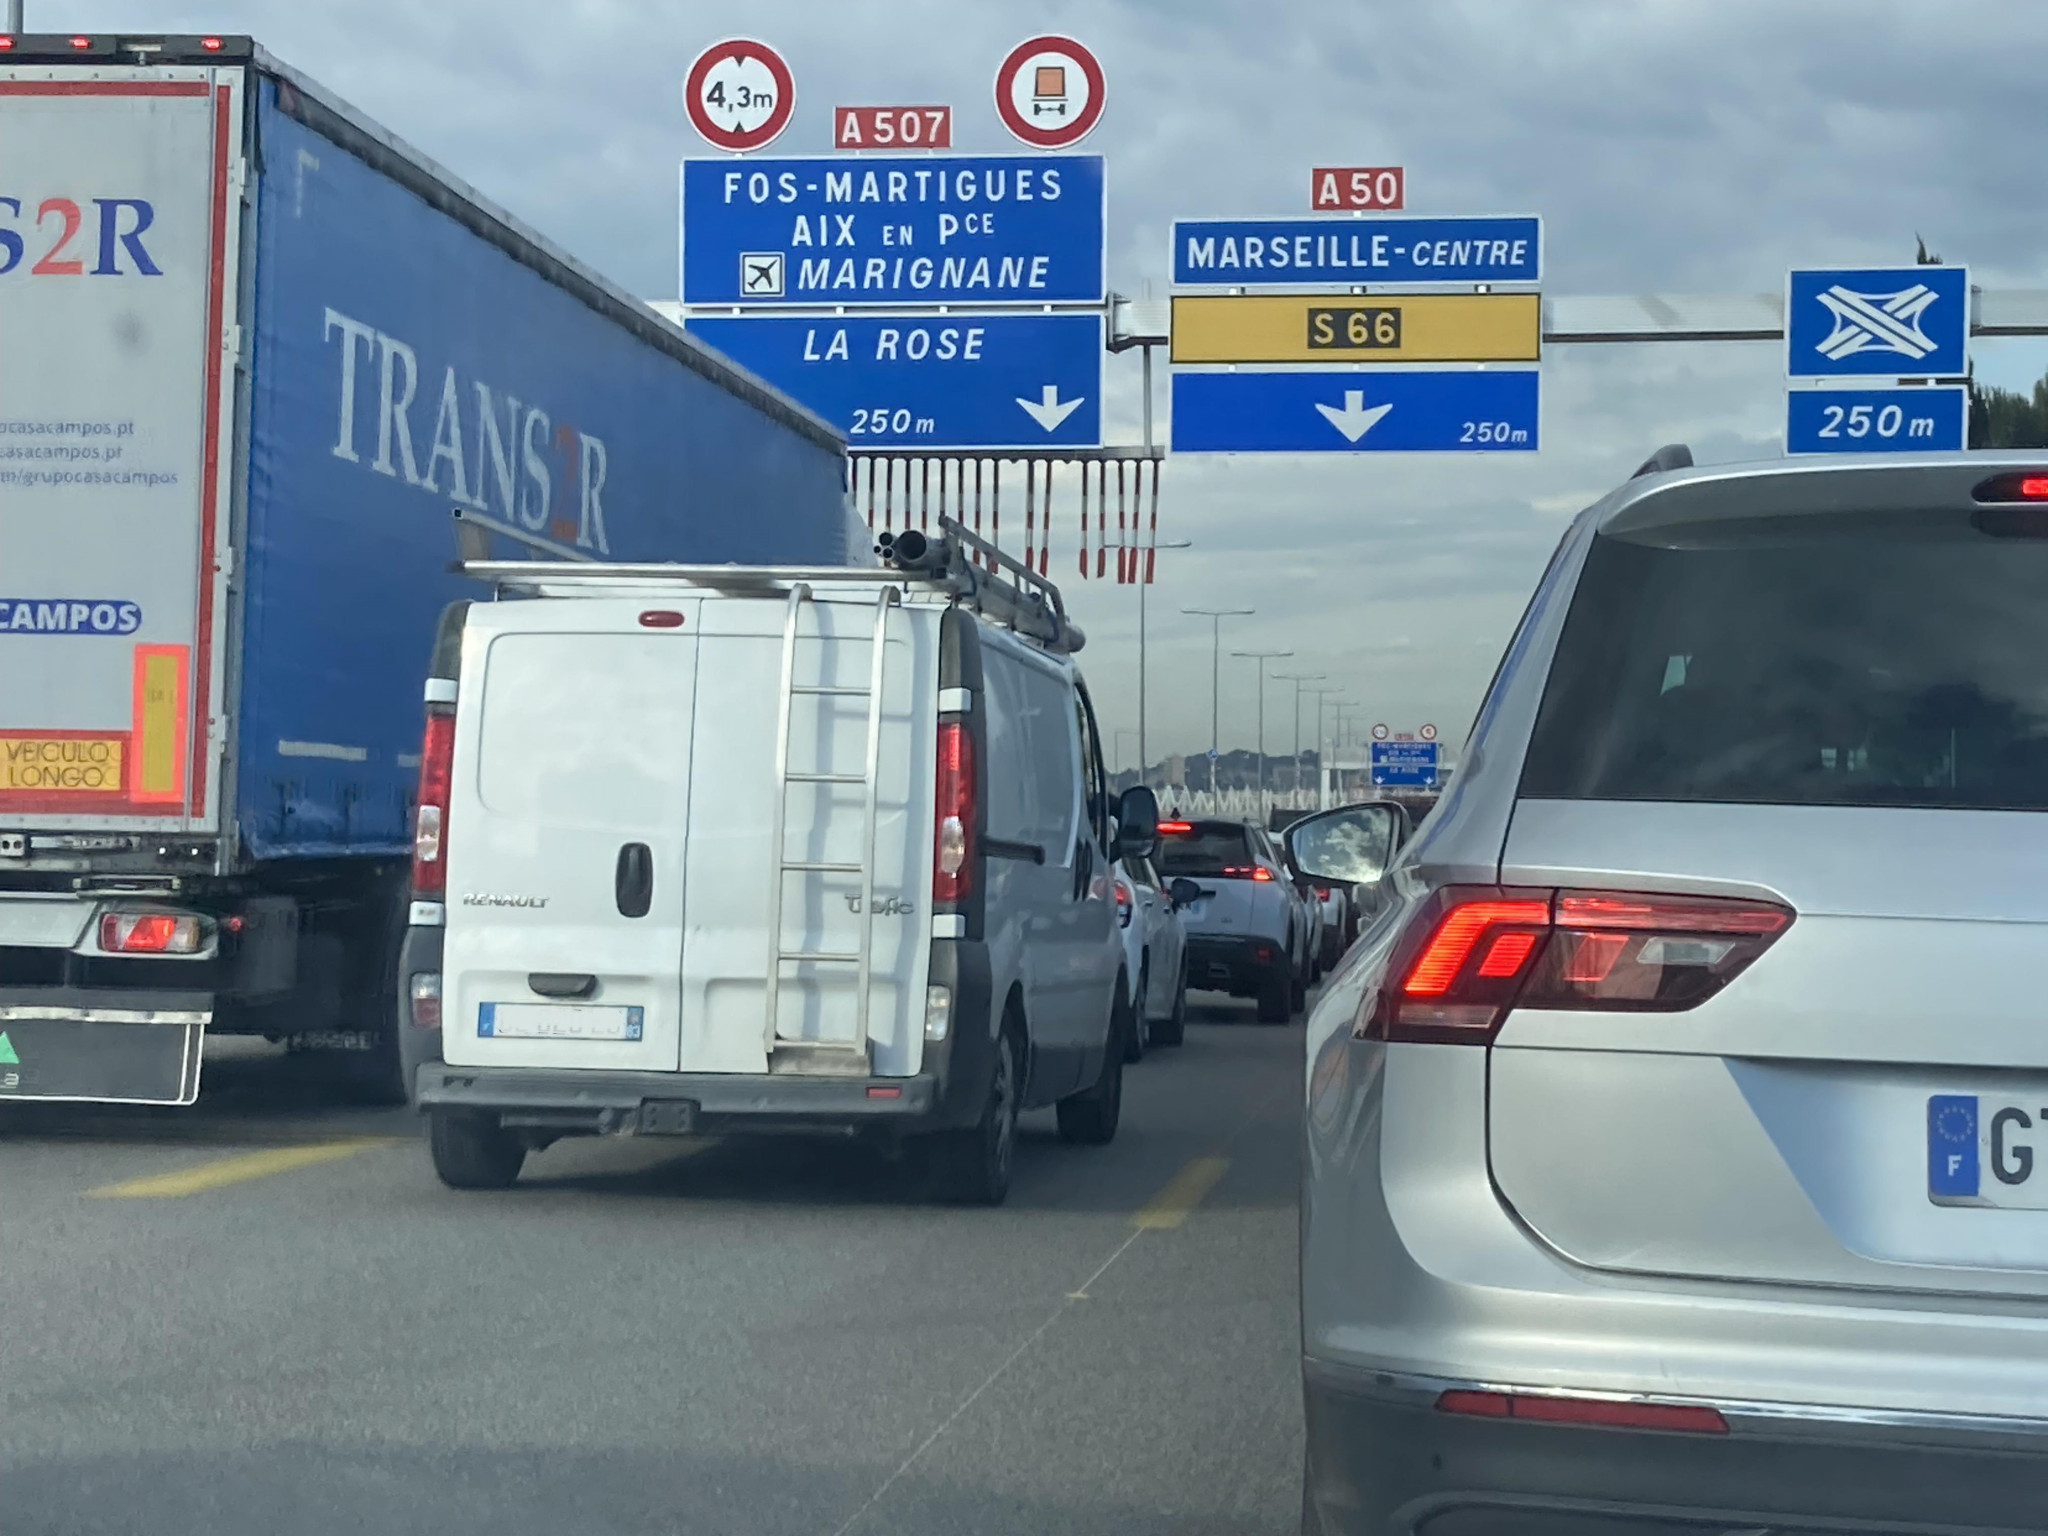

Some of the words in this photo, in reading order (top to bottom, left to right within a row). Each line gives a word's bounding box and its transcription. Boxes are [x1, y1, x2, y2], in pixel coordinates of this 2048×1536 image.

[706, 81, 773, 113] 4,3m
[841, 113, 862, 142] A
[873, 112, 945, 143] 507
[724, 169, 1062, 204] FOS-MARTIGUES
[1318, 173, 1340, 205] A
[1350, 172, 1398, 204] 50
[791, 215, 856, 247] AIX
[882, 225, 913, 246] EN
[1187, 235, 1527, 269] MARSEILLE-CENTRE
[797, 256, 1050, 290] MARIGNANE
[1314, 313, 1334, 344] S
[1347, 312, 1396, 344] 66
[802, 330, 849, 362] LA
[876, 328, 986, 361] ROSE
[9, 765, 104, 788] LONGO
[463, 892, 550, 909] RENAULT
[1948, 1154, 1963, 1177] F
